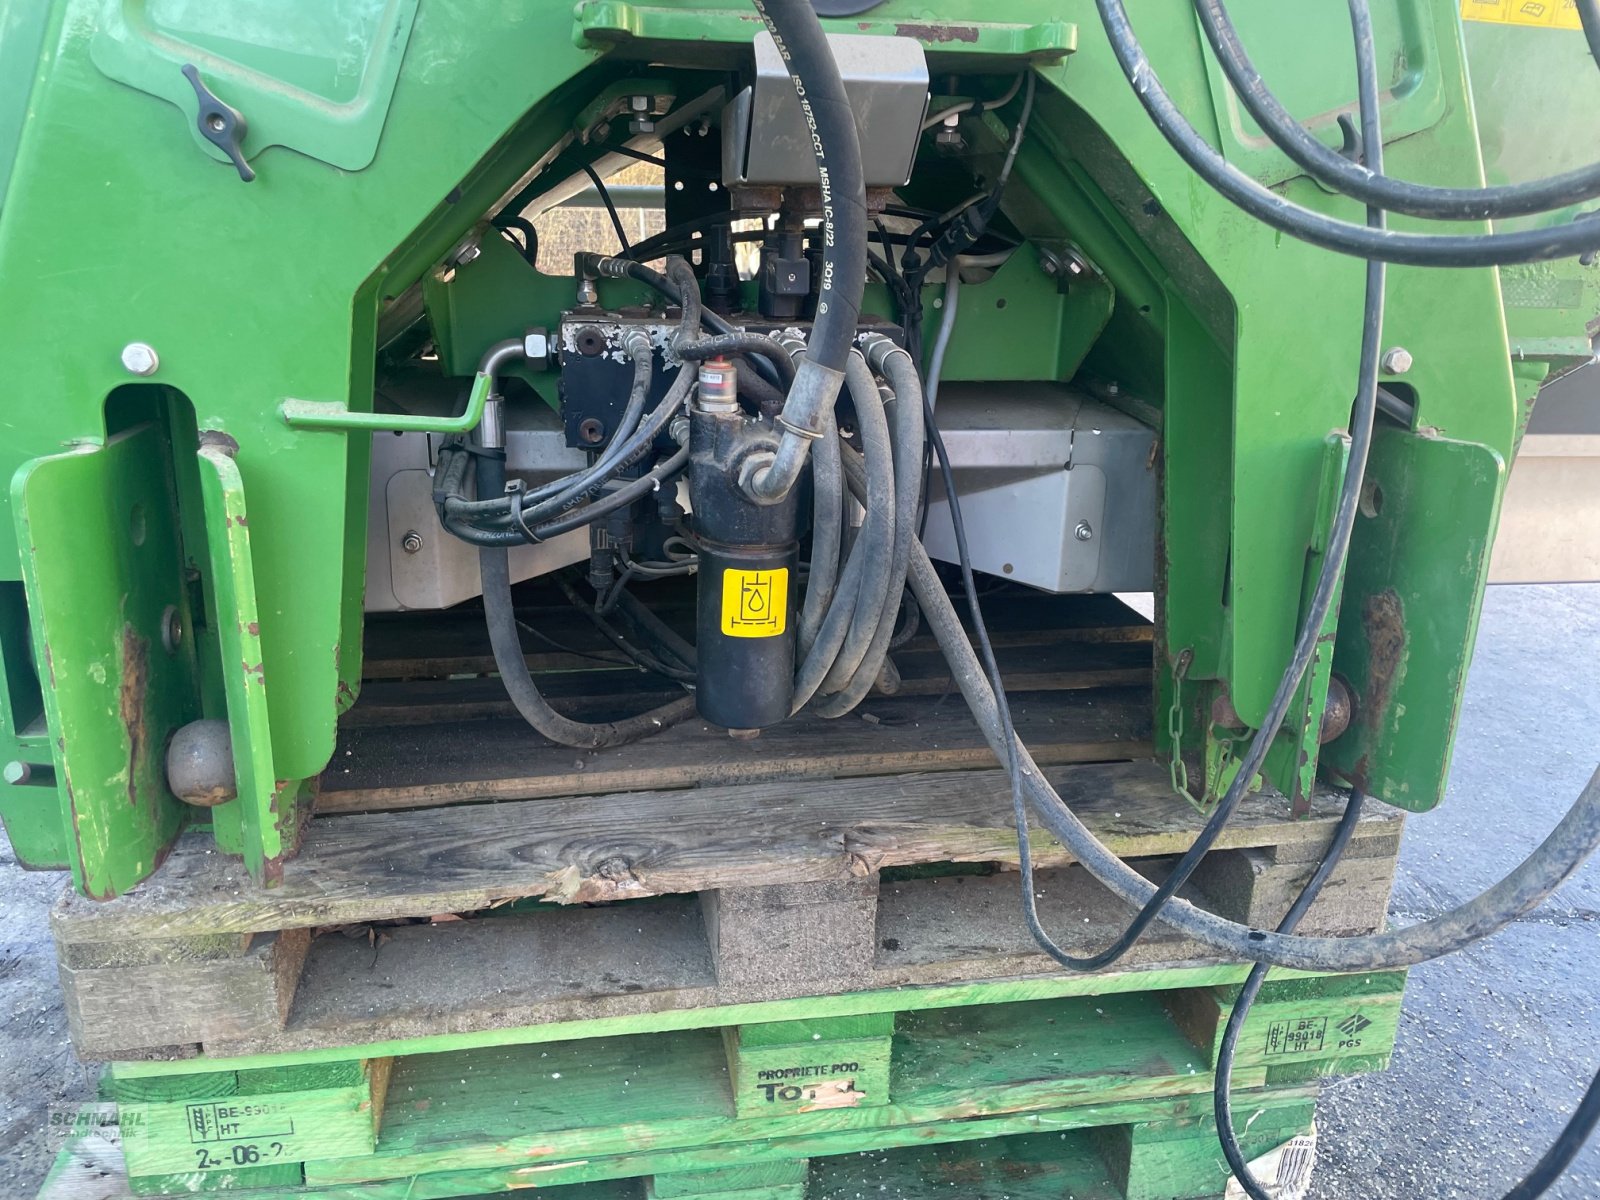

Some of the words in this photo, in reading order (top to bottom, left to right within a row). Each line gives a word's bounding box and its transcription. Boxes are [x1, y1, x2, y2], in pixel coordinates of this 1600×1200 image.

[773, 35, 791, 60] BAR
[791, 74, 806, 96] ISO
[801, 98, 825, 159] 18752-CCT
[819, 166, 832, 203] MSHA
[824, 206, 835, 247] IC-8/22
[1287, 1029, 1323, 1042] 99018
[1338, 1039, 1362, 1049] PGS
[1294, 1041, 1310, 1051] HT
[758, 1064, 829, 1081] PROPRIETE
[220, 1123, 240, 1135] HT
